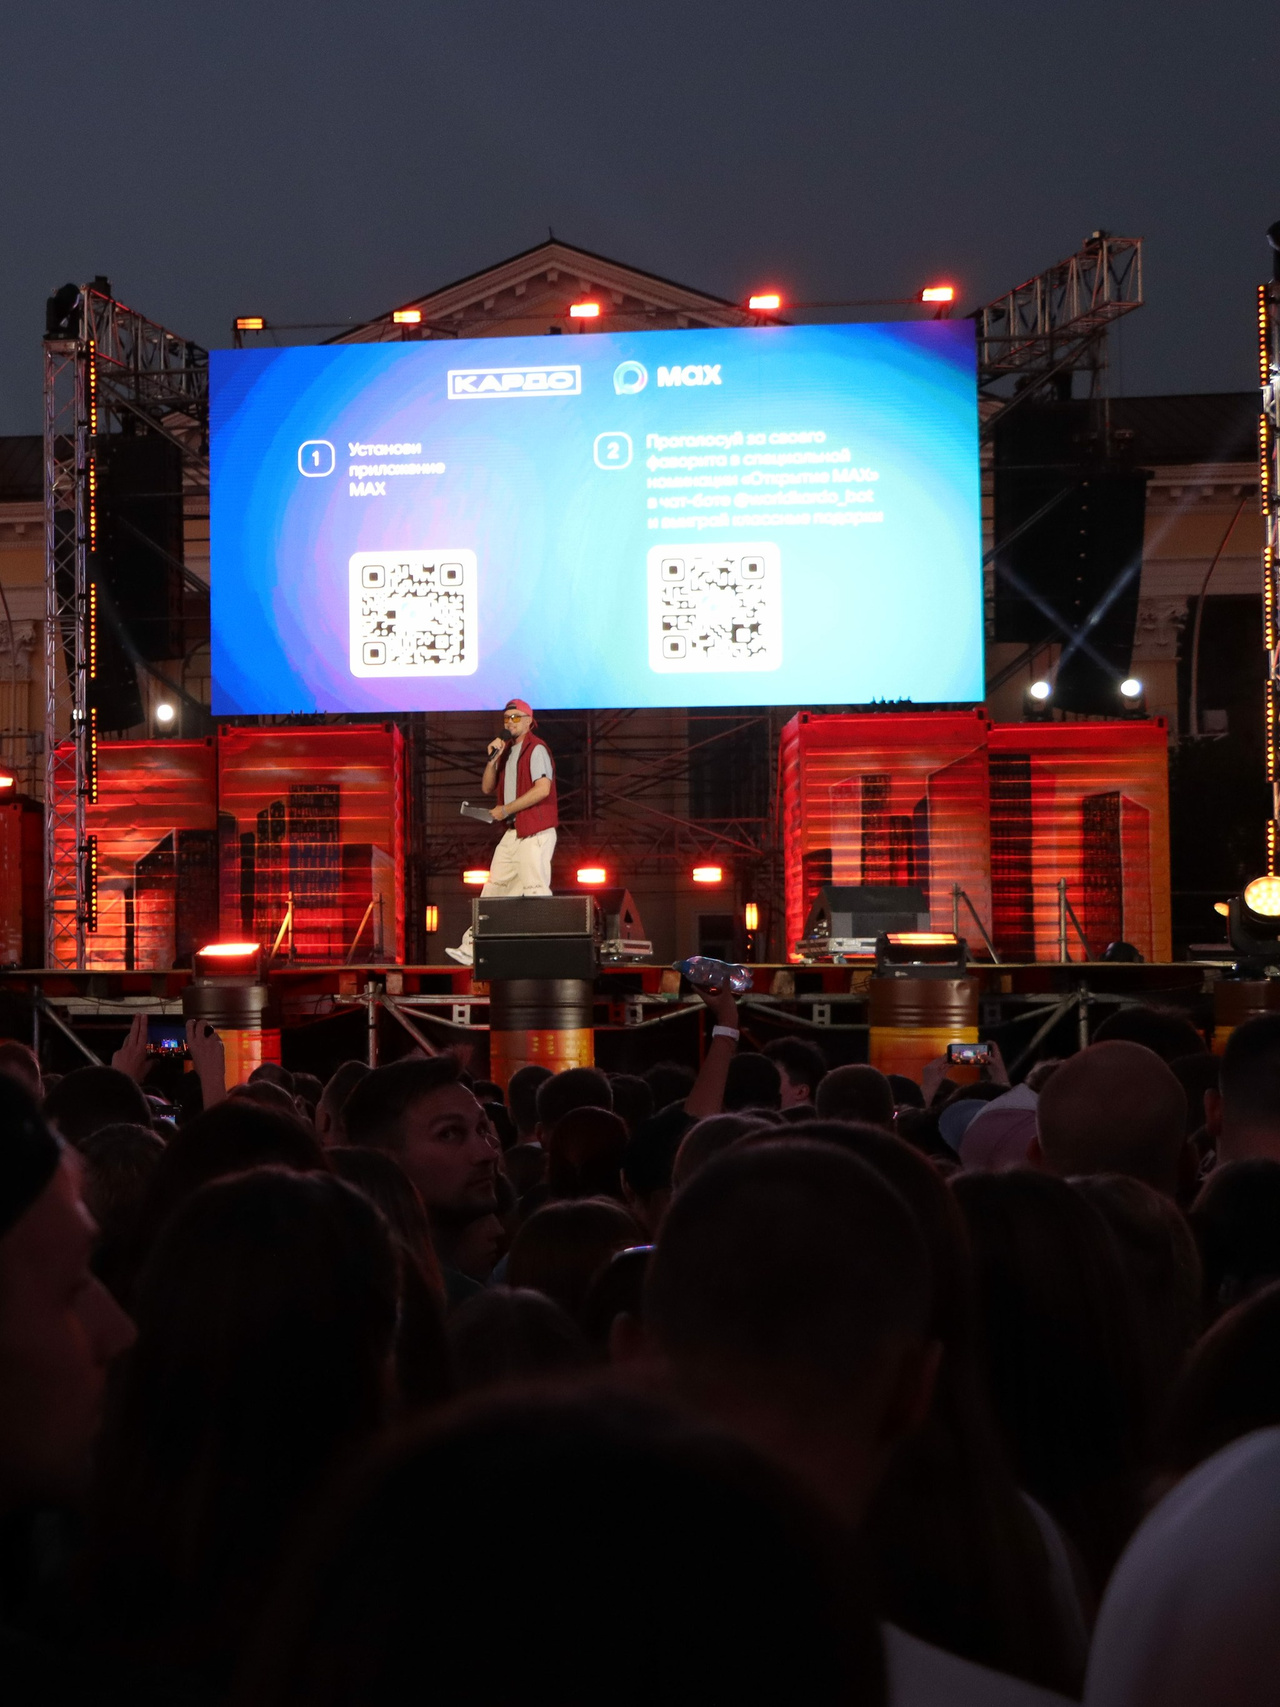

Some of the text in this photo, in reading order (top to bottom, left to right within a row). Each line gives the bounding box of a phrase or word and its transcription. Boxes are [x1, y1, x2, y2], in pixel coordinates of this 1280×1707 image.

[455, 371, 574, 393] КАРДО
[348, 441, 422, 457] Установи
[646, 431, 826, 451] Проголосуй за своего
[312, 450, 320, 467] 1
[606, 441, 620, 460] 2
[348, 462, 446, 480] приложение
